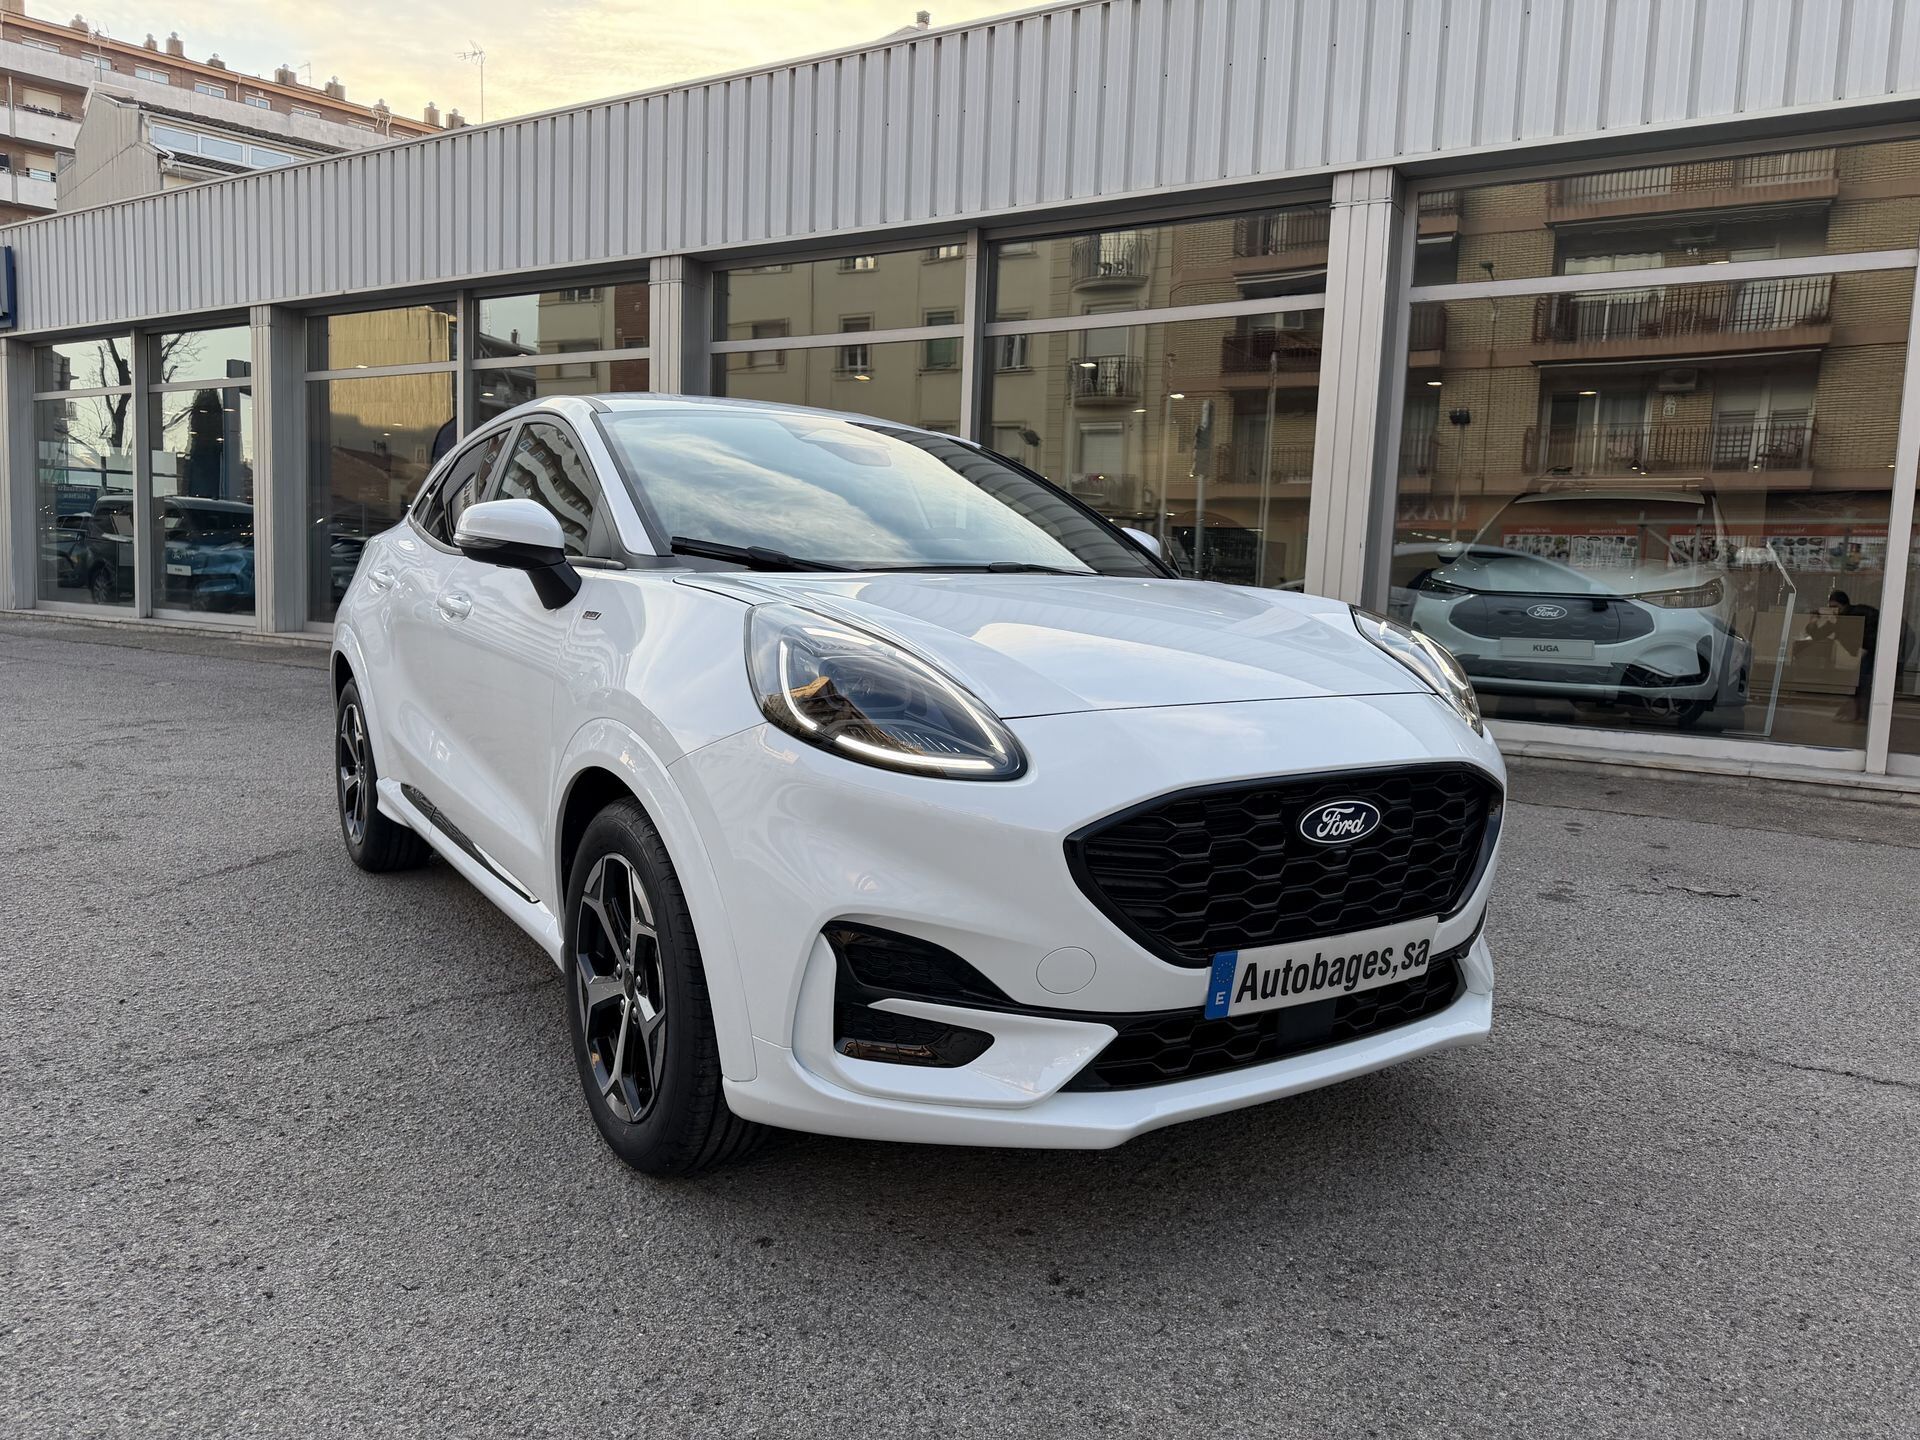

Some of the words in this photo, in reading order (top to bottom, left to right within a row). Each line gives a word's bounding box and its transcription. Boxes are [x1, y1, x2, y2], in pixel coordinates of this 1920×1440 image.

[1533, 606, 1560, 618] Ford
[1532, 644, 1560, 653] KUGA
[1316, 807, 1367, 838] Ford
[1215, 991, 1226, 1006] E
